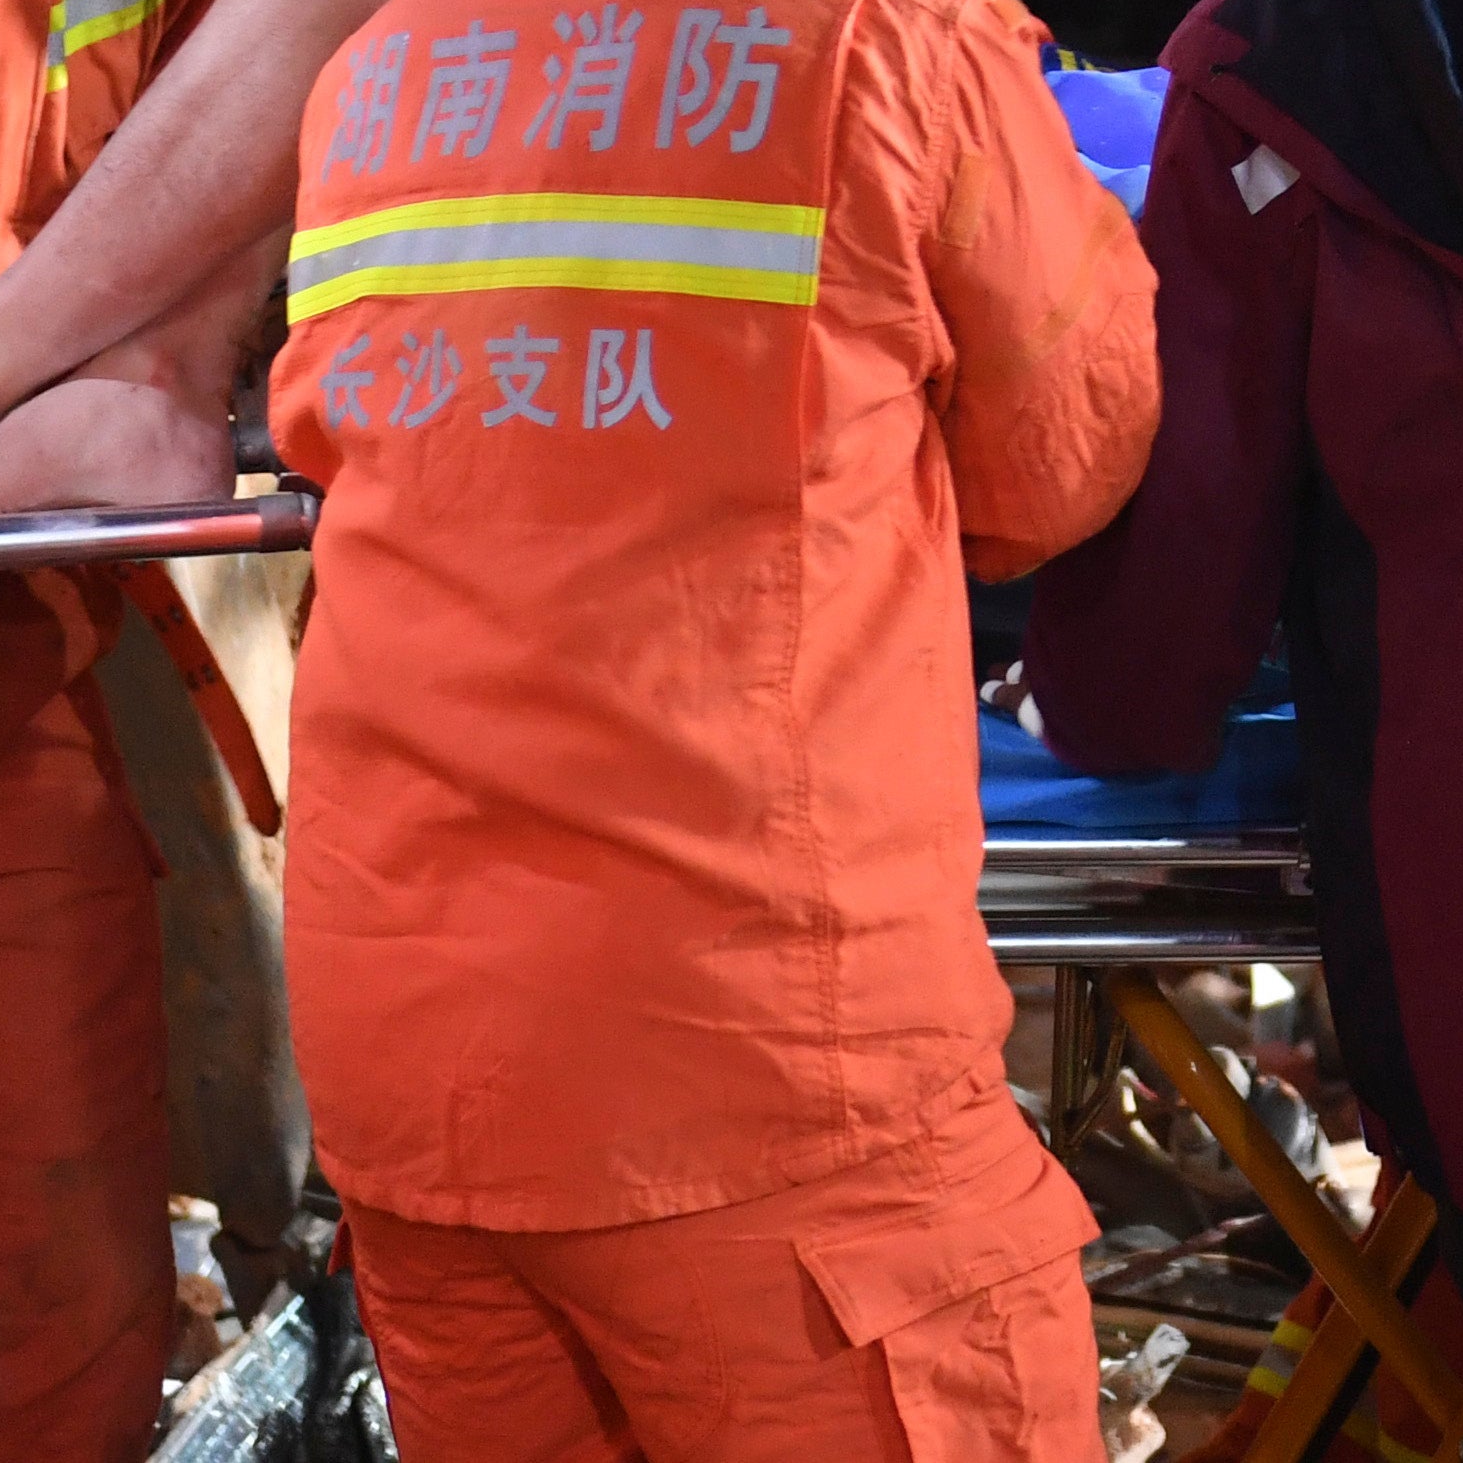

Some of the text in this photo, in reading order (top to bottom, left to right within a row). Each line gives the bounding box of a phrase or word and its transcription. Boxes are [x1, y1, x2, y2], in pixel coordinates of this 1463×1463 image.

[322, 3, 791, 183] 湖南消防
[319, 324, 673, 429] 长沙支队
